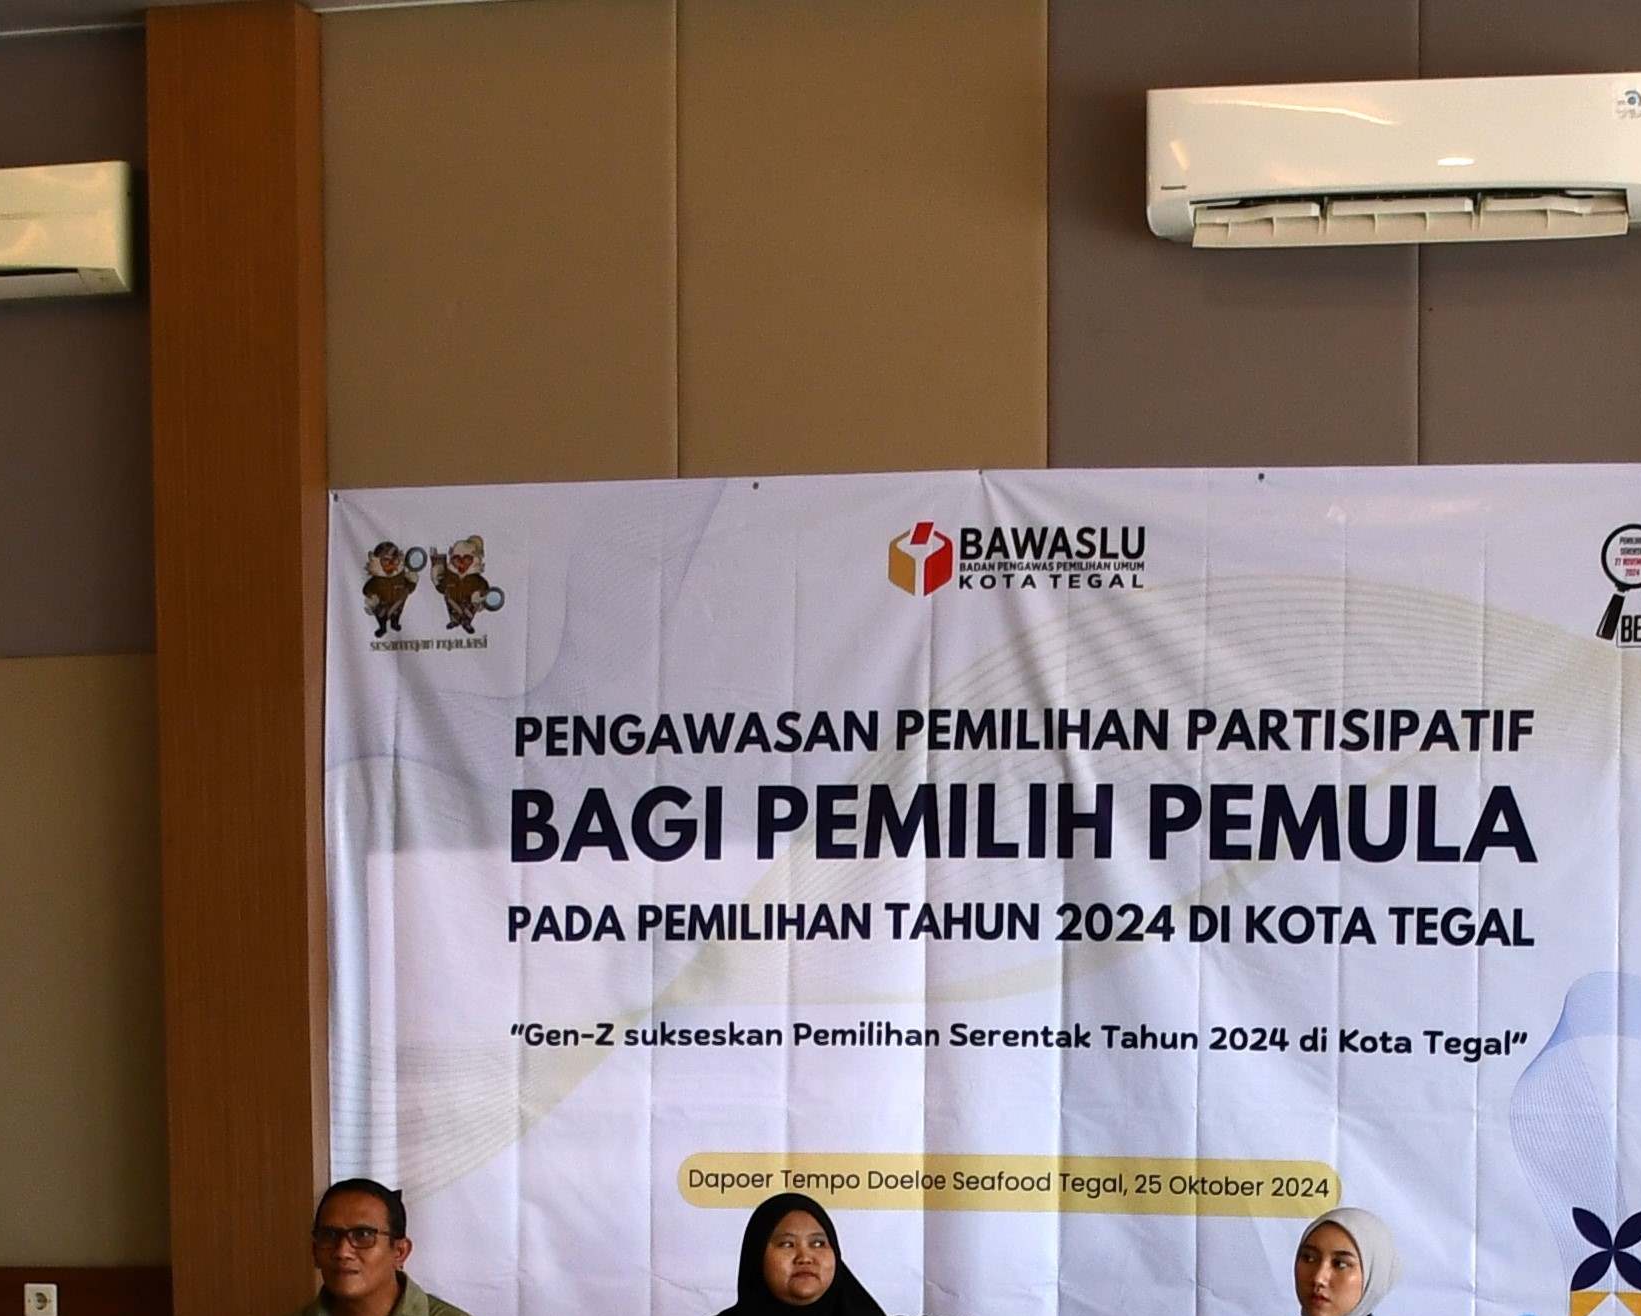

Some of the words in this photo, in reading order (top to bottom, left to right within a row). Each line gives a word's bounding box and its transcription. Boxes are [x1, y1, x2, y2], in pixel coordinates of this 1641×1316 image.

[960, 527, 1145, 560] BAWASLU
[959, 574, 1036, 589] KOTA
[1049, 574, 1144, 589] TEGAL
[960, 562, 995, 572] BADAN
[998, 561, 1054, 571] PENGAWAS
[1114, 561, 1145, 571] UMUM
[516, 711, 878, 756] PENGAWASAN
[897, 708, 1168, 750] PEMILIHAN
[1188, 709, 1534, 751] PARTISIPATIF
[511, 786, 722, 862] BAGI
[758, 782, 1113, 859] PEMILIH
[1150, 784, 1537, 862] PEMULA
[509, 905, 625, 942] PADA
[638, 903, 871, 941] PEMILIHAN
[885, 903, 1039, 940] TAHUN
[1056, 903, 1175, 941] 2024
[1190, 905, 1230, 942] DI
[1246, 906, 1376, 944] KOTA
[1389, 907, 1534, 946] TEGAL
[625, 1022, 782, 1046] sukseskan
[793, 1022, 939, 1046] Pemilihan
[950, 1023, 1090, 1048] Serentak
[1101, 1024, 1197, 1049] Tahun
[1210, 1027, 1289, 1051] 2024
[1300, 1027, 1327, 1052] di
[1340, 1029, 1411, 1053] Kota
[690, 1170, 773, 1194] Dapoer
[781, 1170, 859, 1194] Tempo
[868, 1171, 946, 1190] Doeloe
[953, 1171, 1050, 1191] Seafood
[1060, 1173, 1127, 1198] Tegal,
[1135, 1174, 1161, 1194] 25
[1169, 1176, 1264, 1196] Oktober
[1272, 1177, 1329, 1197] 2024
